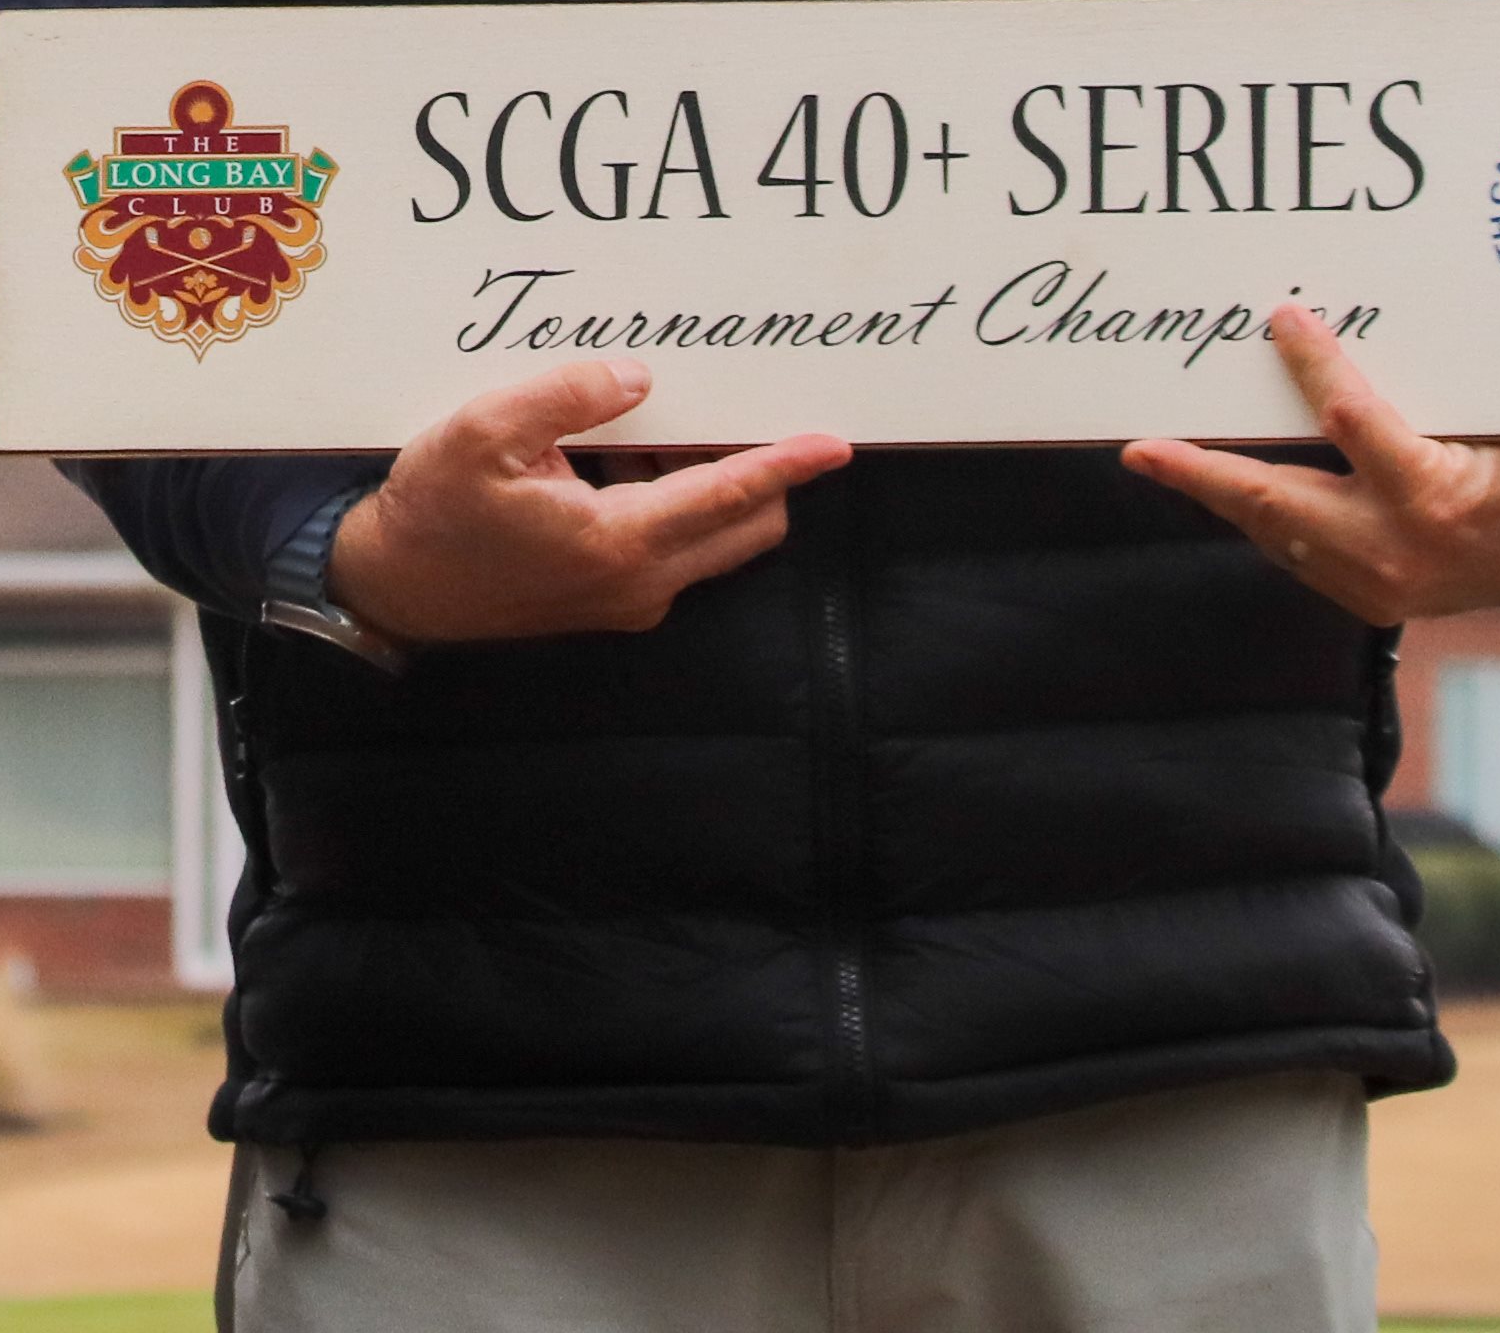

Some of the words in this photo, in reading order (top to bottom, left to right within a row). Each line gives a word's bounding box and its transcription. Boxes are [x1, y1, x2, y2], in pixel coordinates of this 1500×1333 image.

[163, 136, 239, 153] THE
[410, 89, 733, 223] SCGA
[756, 90, 970, 219] 40+
[1007, 79, 1426, 217] SERIES
[110, 163, 212, 187] LONG
[226, 161, 292, 187] BAY
[127, 197, 274, 215] CLUB
[456, 268, 958, 354] Tournament
